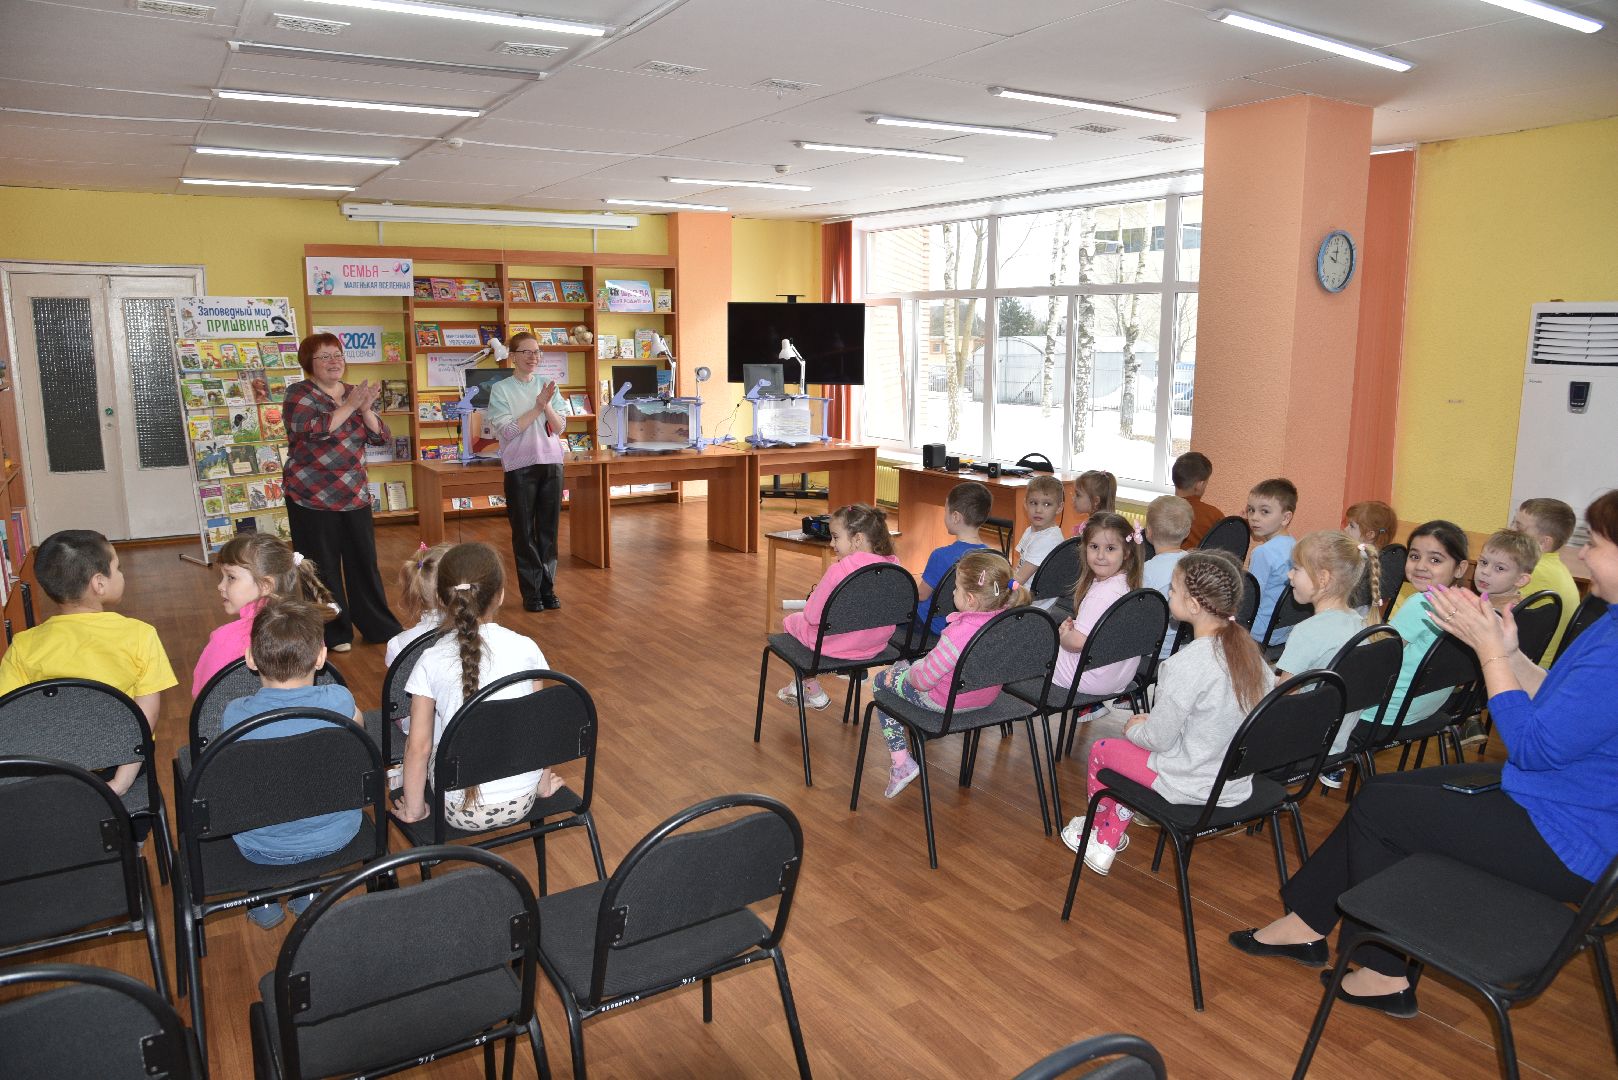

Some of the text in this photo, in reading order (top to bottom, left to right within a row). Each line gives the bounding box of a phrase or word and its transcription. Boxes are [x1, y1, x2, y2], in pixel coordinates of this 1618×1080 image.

[342, 264, 379, 278] СЕМЬЯ
[343, 281, 411, 290] МАЛЕНЬКАЯ ВСЕЛЕННАЯ
[197, 305, 272, 320] Заповедный мир
[206, 319, 269, 333] ПРИШВИНА
[343, 332, 376, 350] 2024
[355, 350, 376, 358] СЕМЬИ
